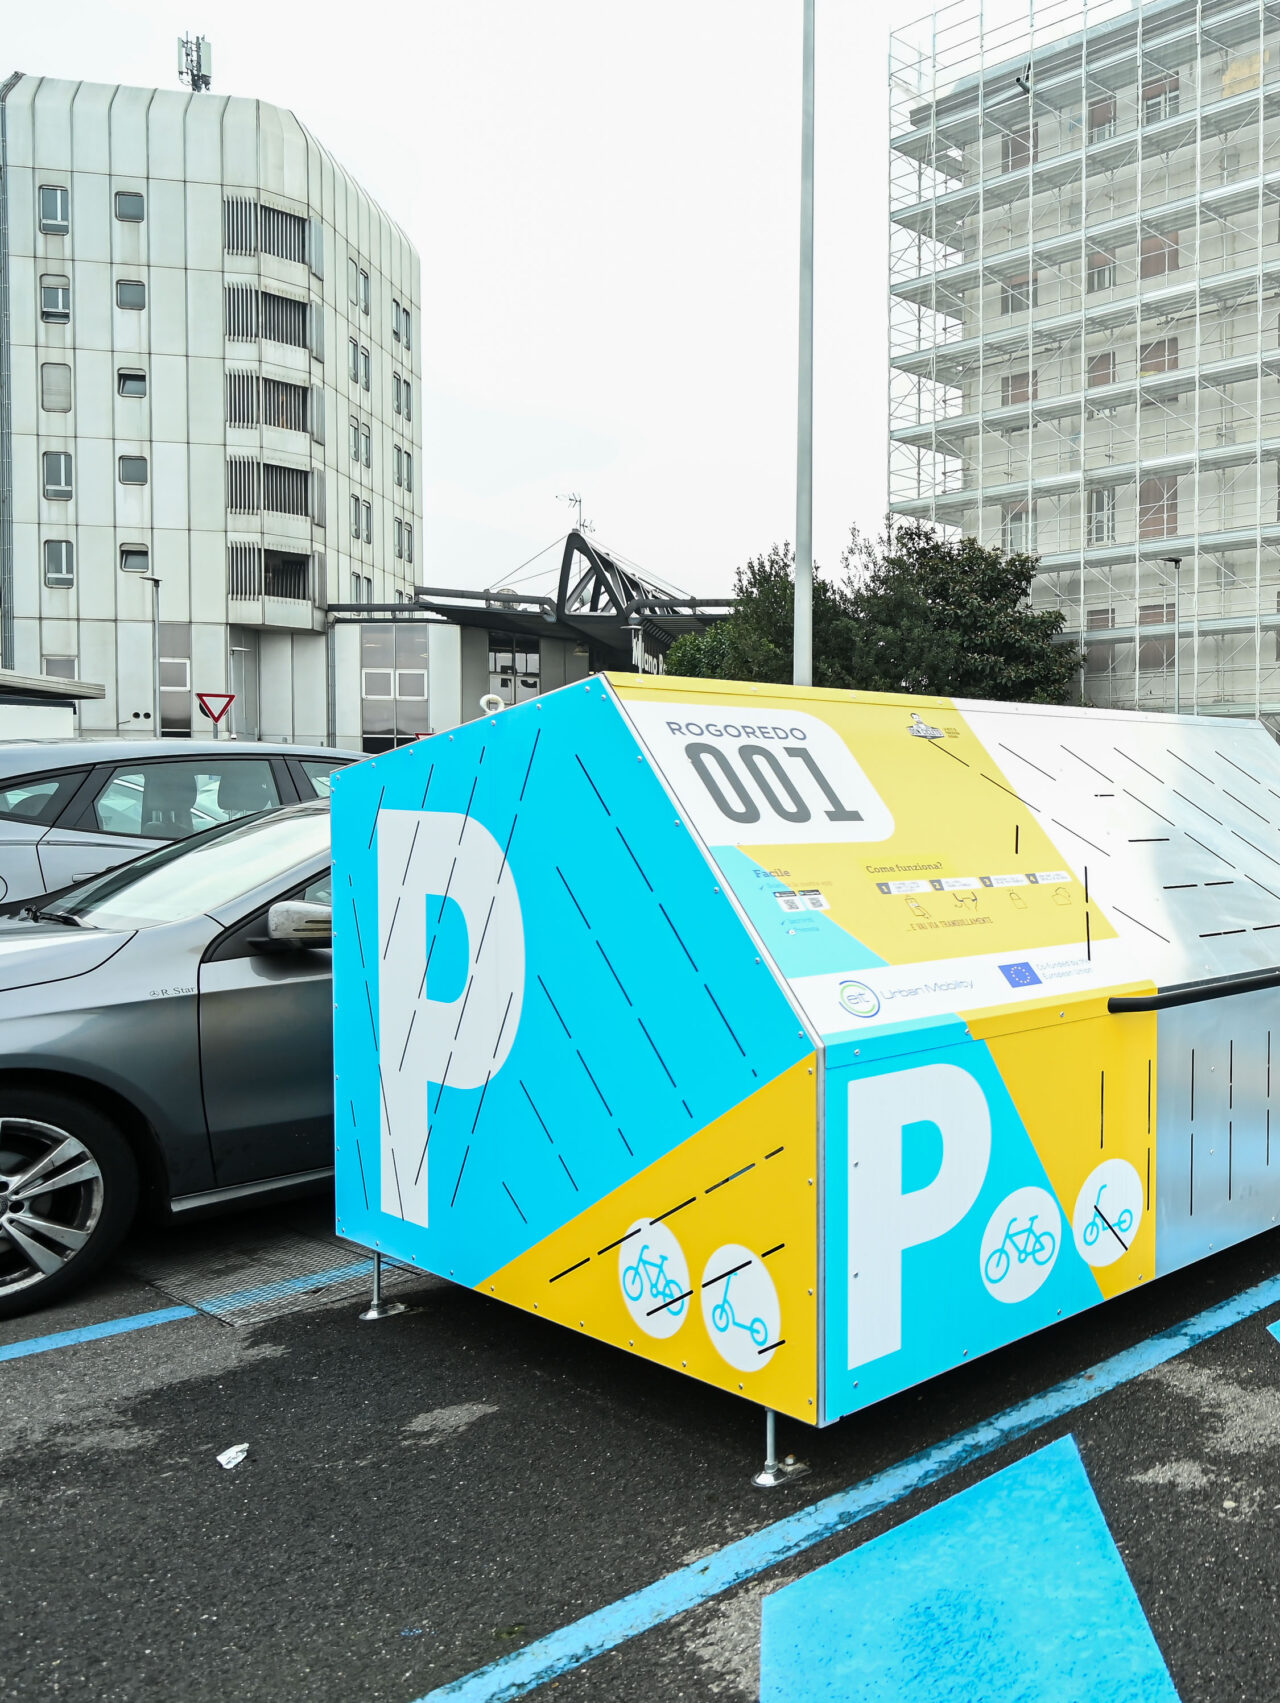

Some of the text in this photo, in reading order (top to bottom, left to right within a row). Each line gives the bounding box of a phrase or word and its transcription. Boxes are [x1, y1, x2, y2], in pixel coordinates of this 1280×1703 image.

[665, 721, 808, 741] ROGOREDO
[684, 742, 865, 824] 001
[752, 869, 791, 878] Facile
[866, 861, 943, 874] Come funziona?
[377, 809, 525, 1229] P
[847, 1062, 992, 1372] P
